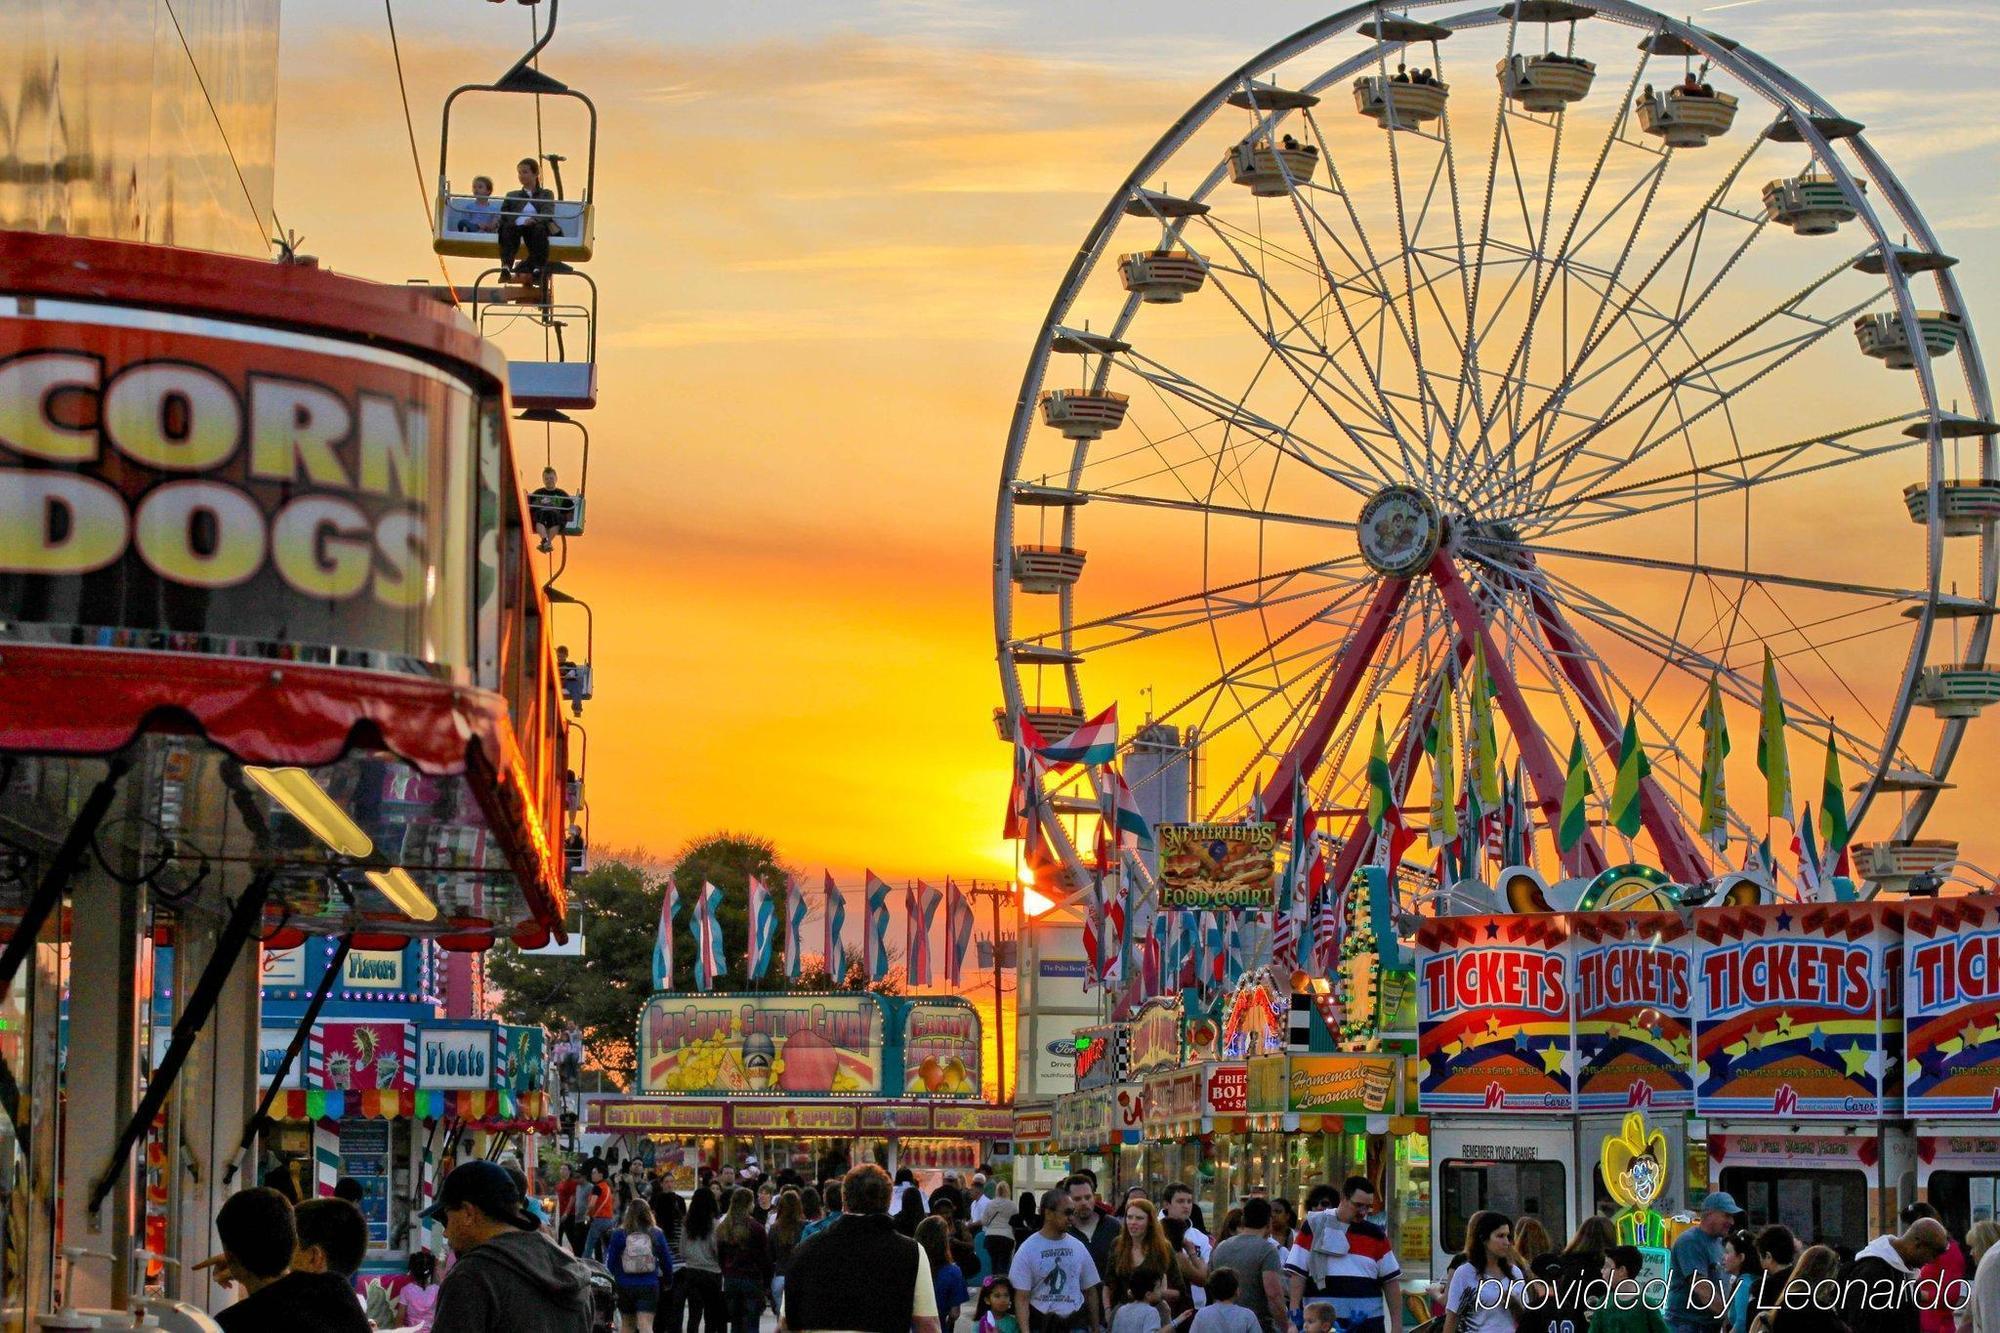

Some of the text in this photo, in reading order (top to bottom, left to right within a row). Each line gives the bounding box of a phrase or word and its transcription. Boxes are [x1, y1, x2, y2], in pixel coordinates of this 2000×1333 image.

[0, 350, 429, 499] CORN
[0, 467, 429, 608] DOGS
[1164, 887, 1272, 905] FOOD COURT
[349, 953, 397, 980] Flavors
[1704, 944, 1870, 1012] TICKETS
[1424, 950, 1566, 1013] TICKETS
[1578, 949, 1690, 1012] TICKETS
[911, 1011, 974, 1040] CANDY
[426, 1041, 484, 1077] Floats
[1055, 1041, 1076, 1054] For
[1218, 1075, 1246, 1084] FRIE
[1291, 1061, 1367, 1090] Homemade
[1212, 1087, 1246, 1099] BOL
[1296, 1082, 1366, 1109] Lemonade
[1544, 1092, 1571, 1107] Cares
[1844, 1096, 1875, 1112] Cares
[607, 1108, 658, 1125] COTTON
[673, 1109, 721, 1126] CANDY
[735, 1110, 782, 1127] CANDY
[1462, 1144, 1494, 1159] REMEMBER
[1495, 1146, 1511, 1160] YOUR
